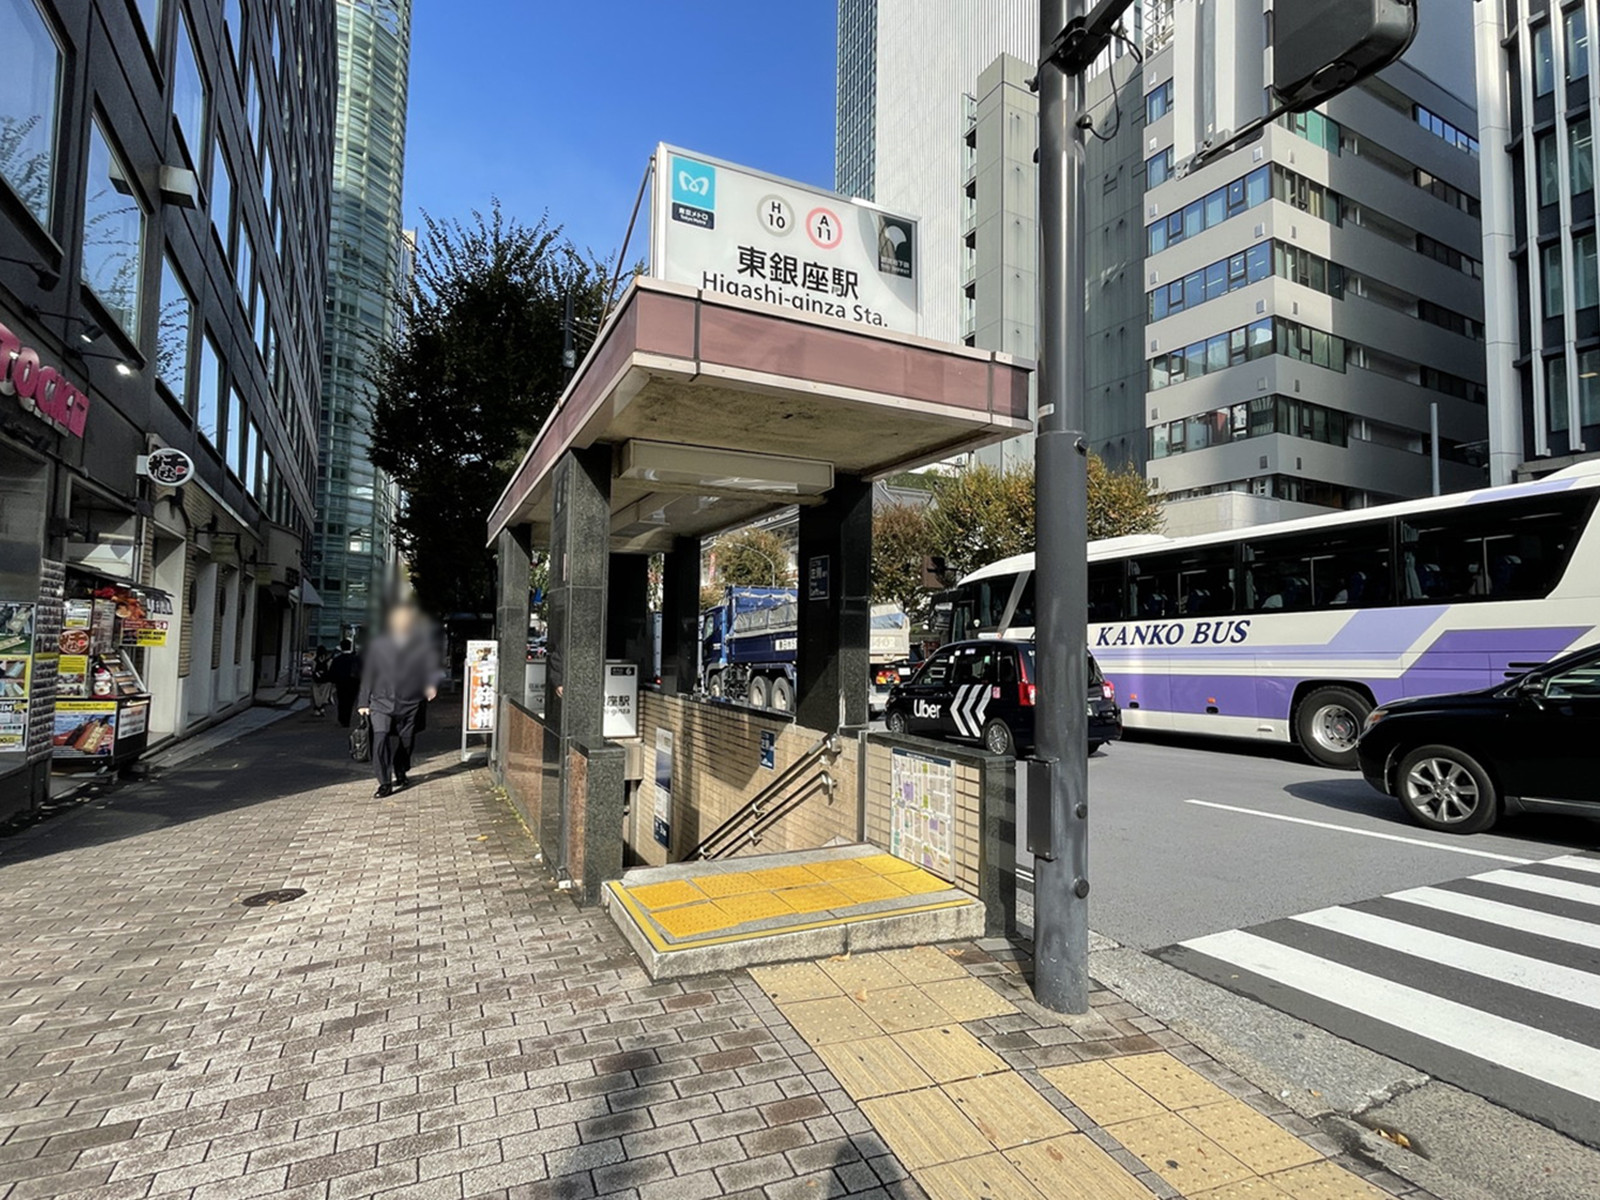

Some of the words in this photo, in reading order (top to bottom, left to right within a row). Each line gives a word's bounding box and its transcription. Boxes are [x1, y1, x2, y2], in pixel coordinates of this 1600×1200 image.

[771, 201, 782, 214] H
[768, 213, 785, 229] 10
[819, 214, 830, 228] A
[816, 225, 832, 241] 11
[737, 245, 859, 300] 東銀座駅
[853, 304, 888, 328] Sta.
[1096, 623, 1185, 646] KANKO
[1190, 619, 1251, 644] BUS
[913, 698, 942, 720] Uber
